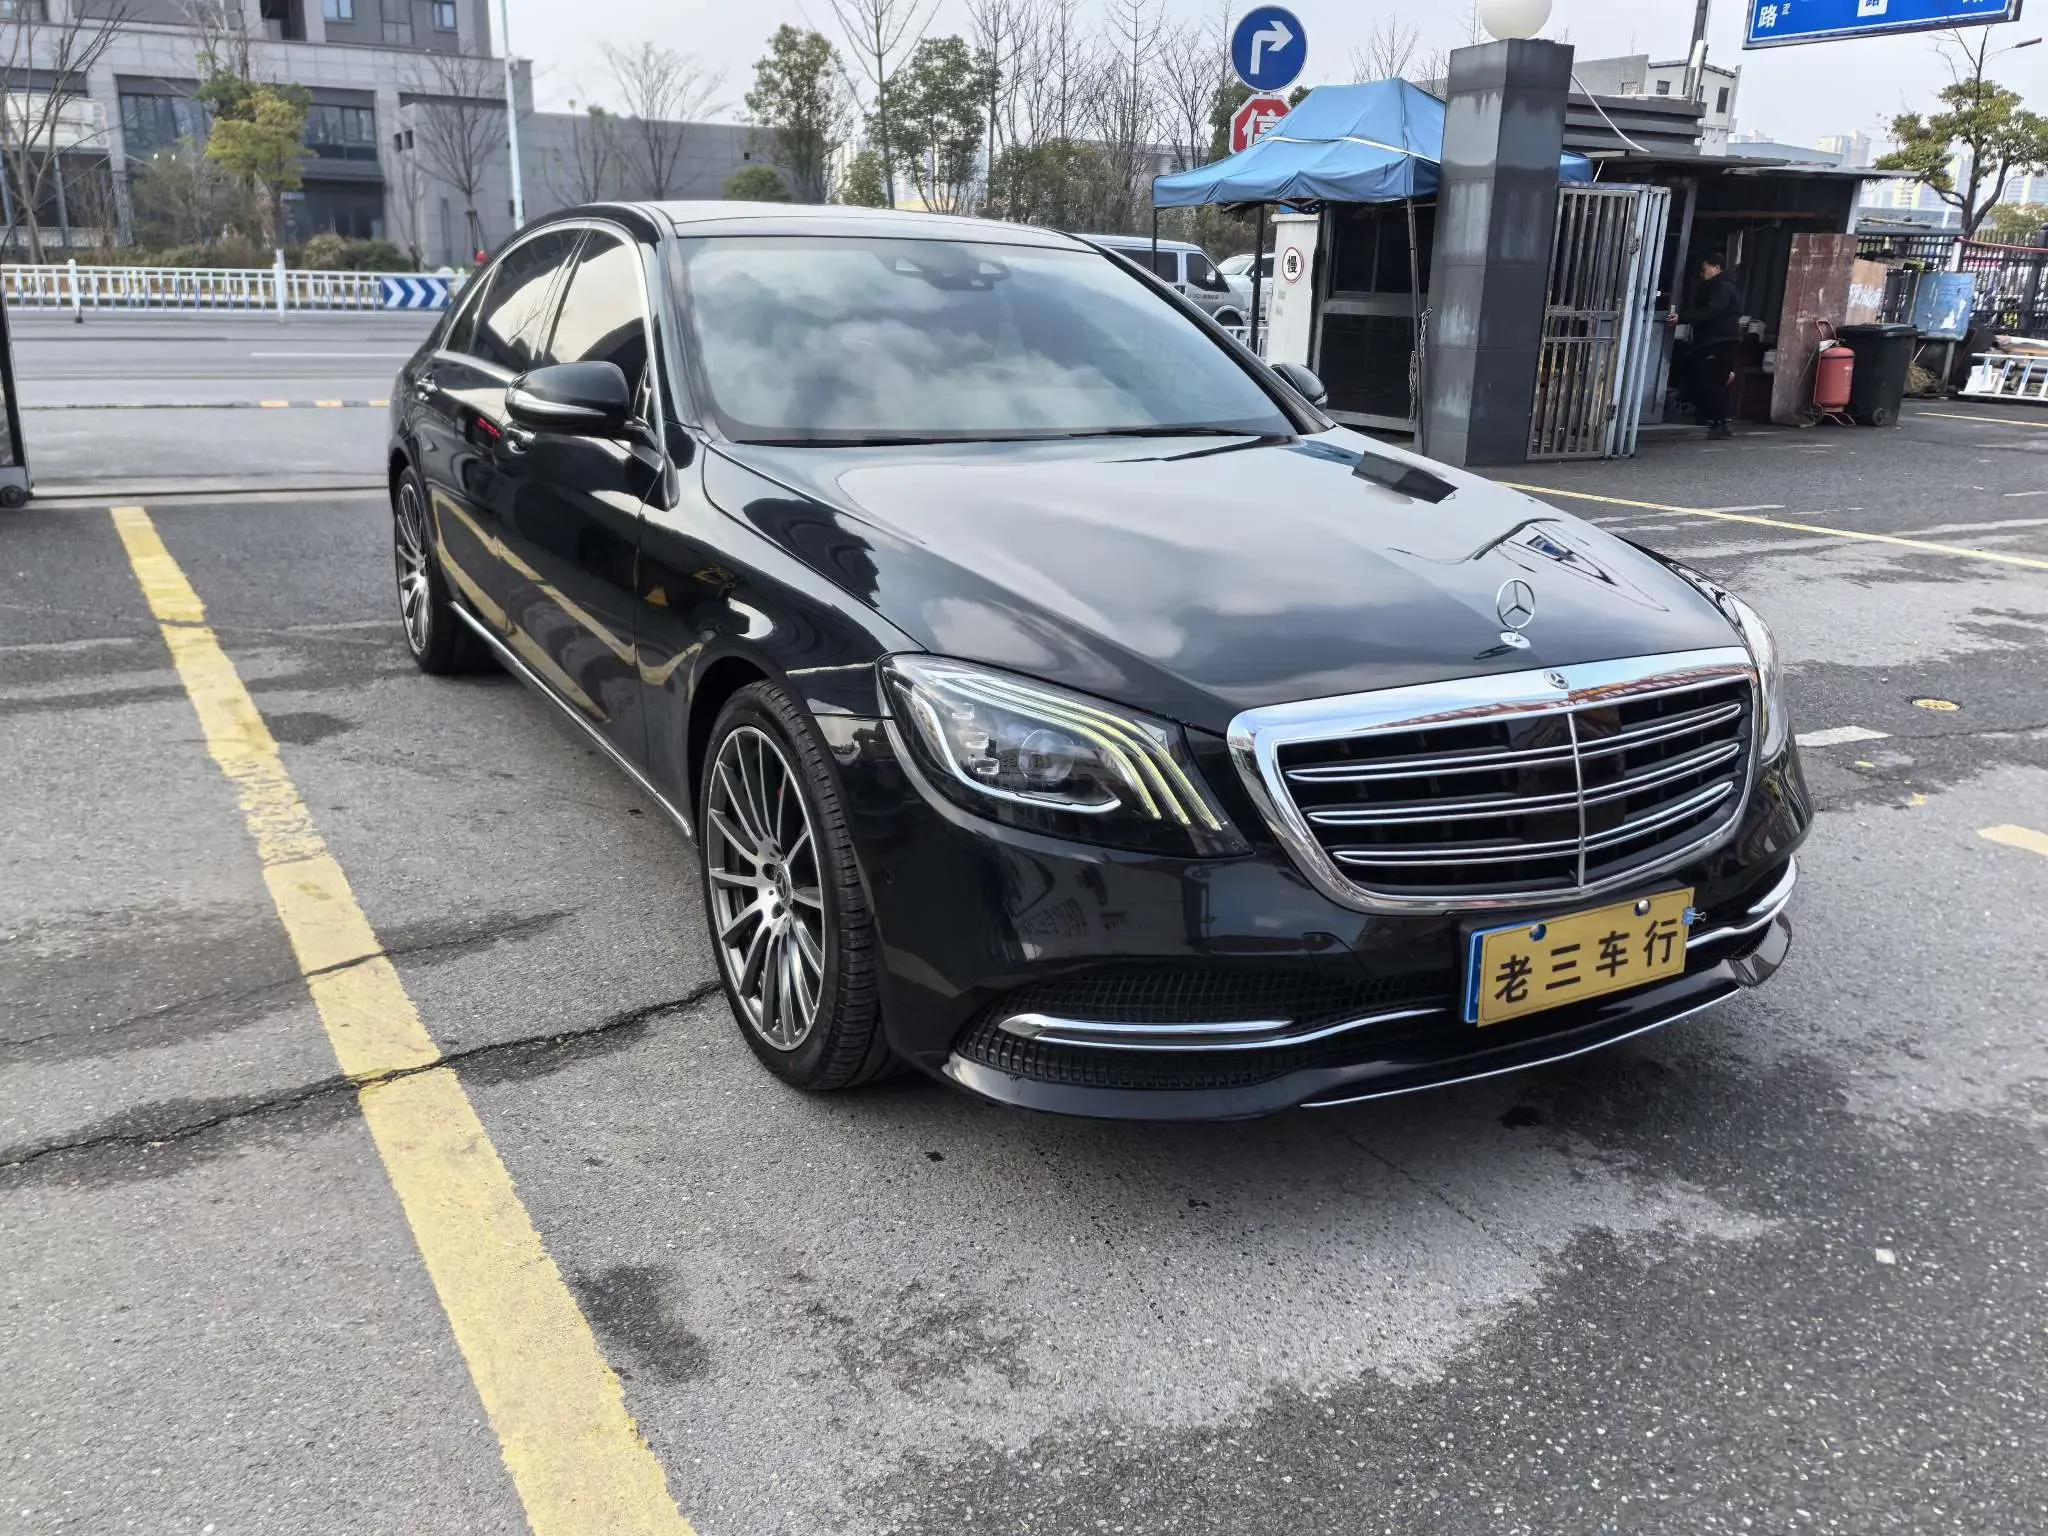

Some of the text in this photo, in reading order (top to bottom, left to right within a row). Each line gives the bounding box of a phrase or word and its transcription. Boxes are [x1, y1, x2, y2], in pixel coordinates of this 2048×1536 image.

[1758, 4, 1777, 28] 路
[1287, 255, 1297, 273] 慢
[1494, 918, 1678, 1004] 老三车行
